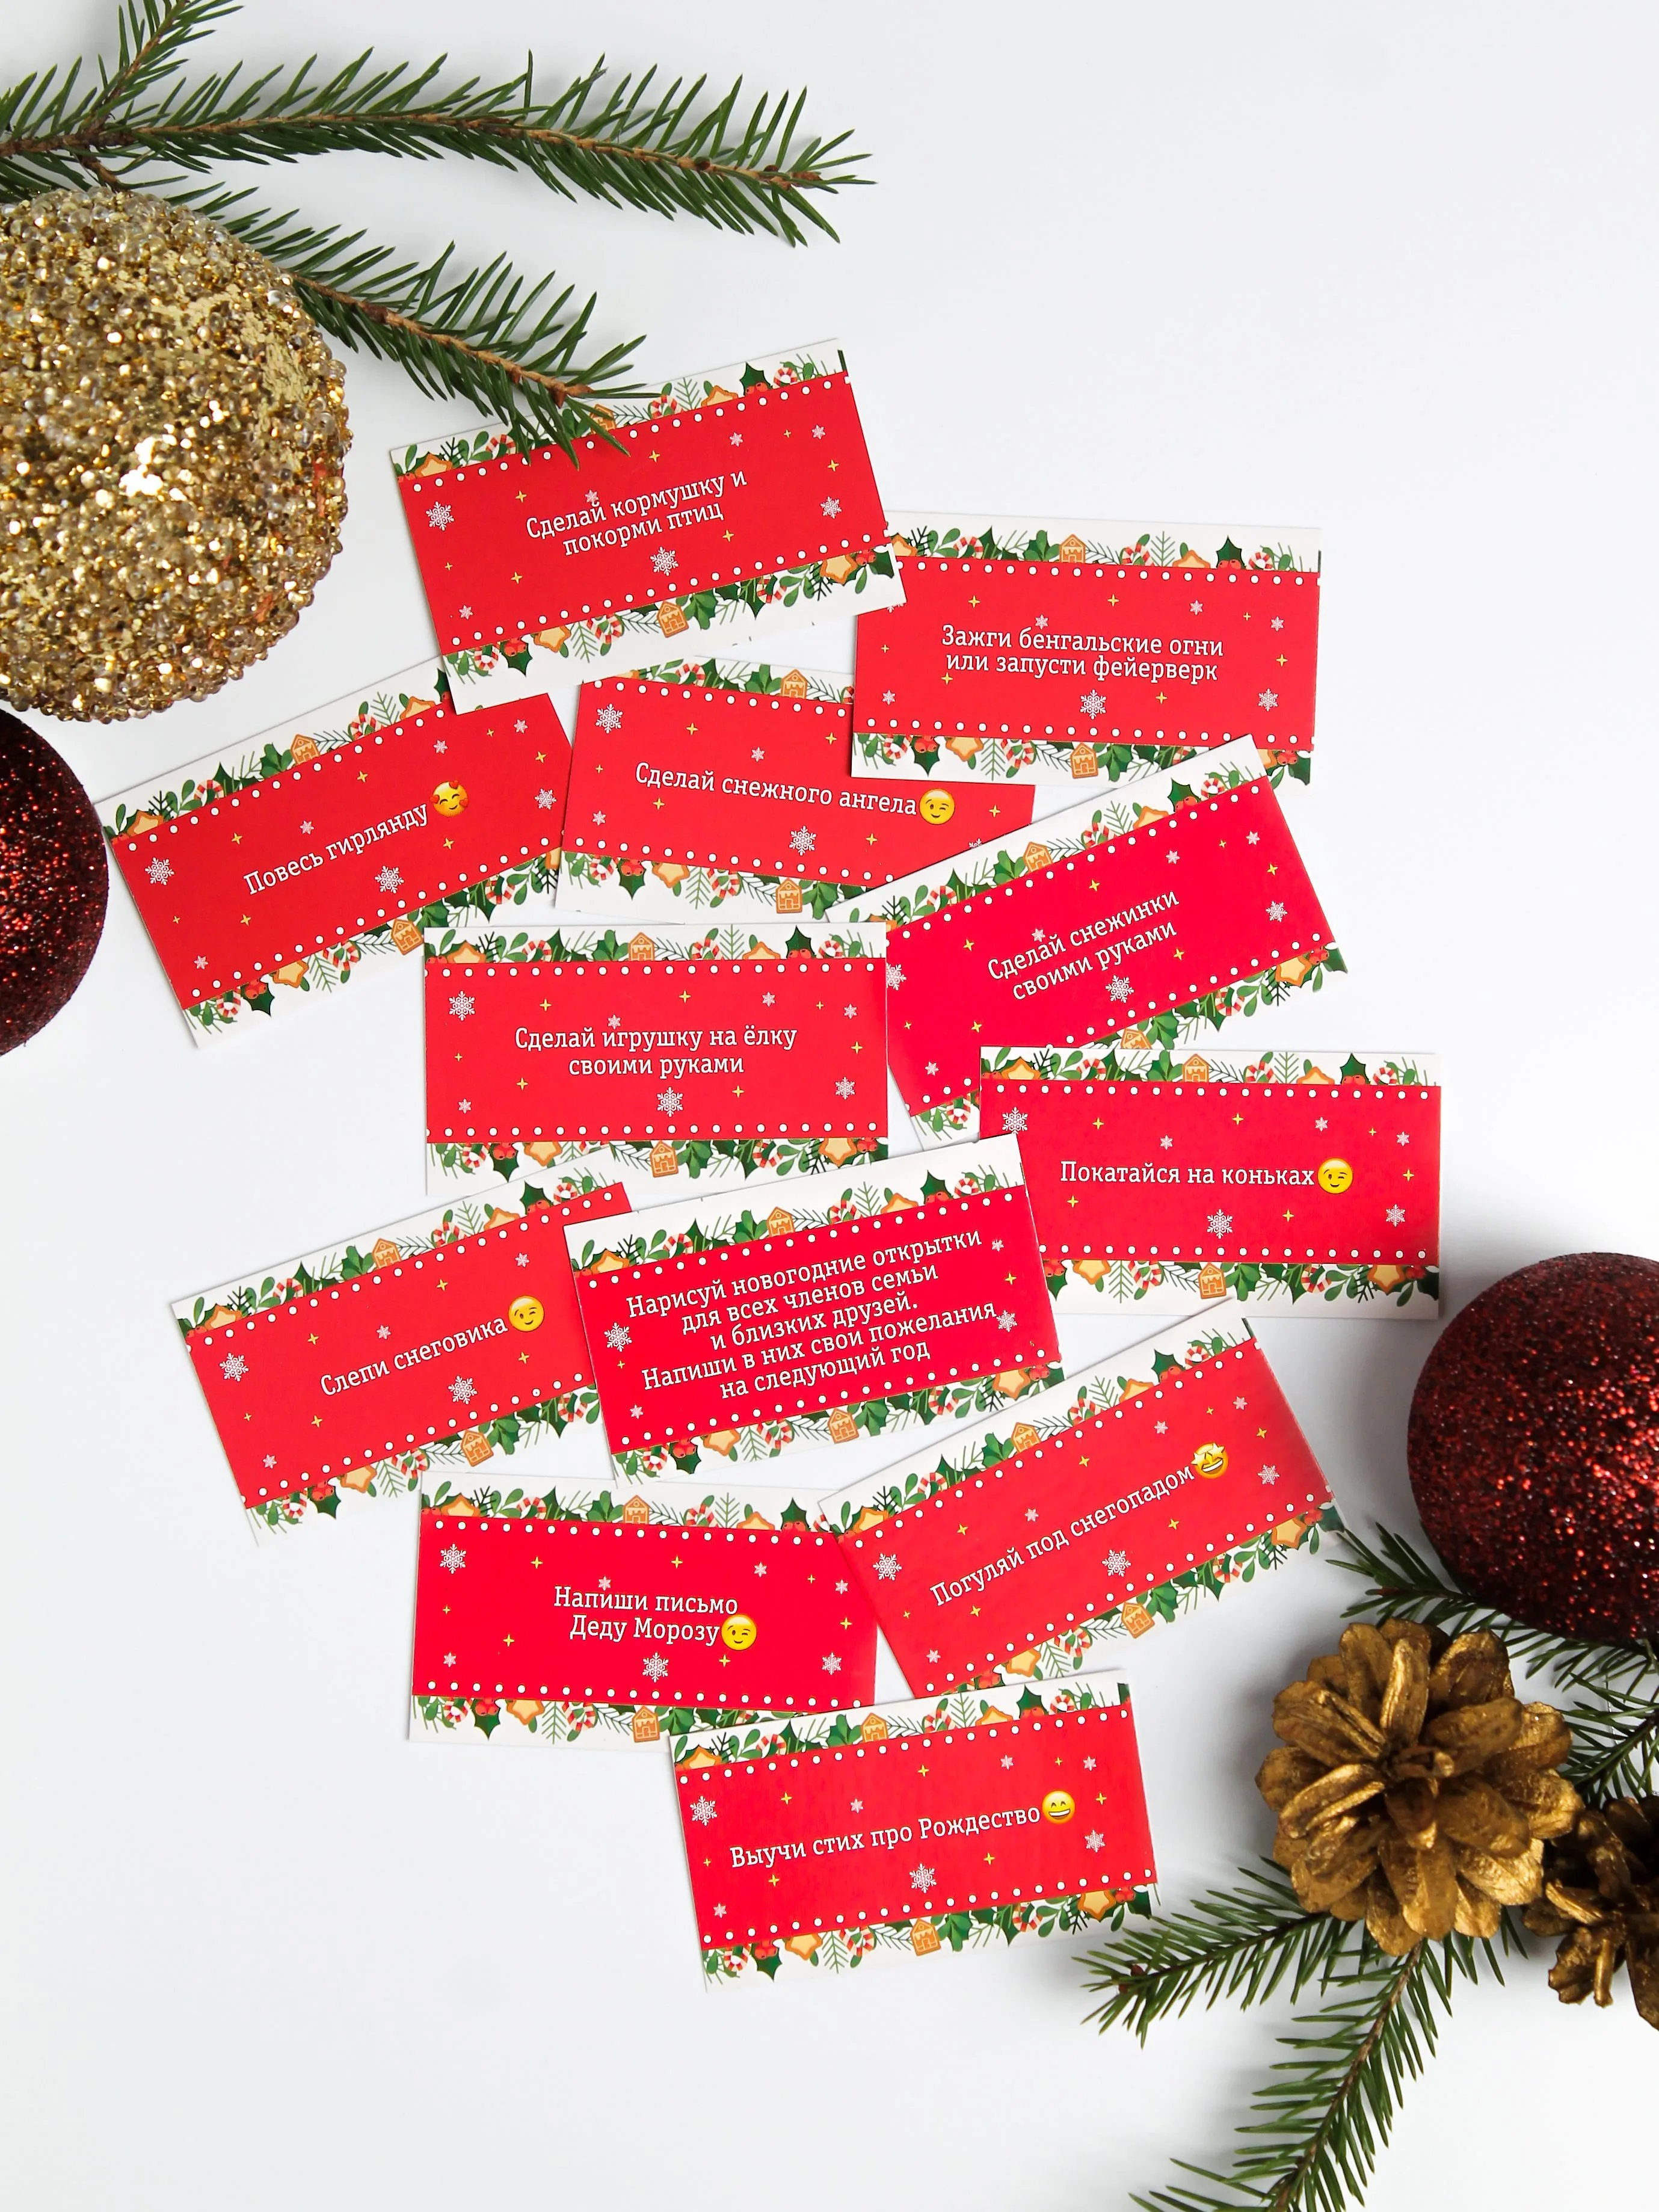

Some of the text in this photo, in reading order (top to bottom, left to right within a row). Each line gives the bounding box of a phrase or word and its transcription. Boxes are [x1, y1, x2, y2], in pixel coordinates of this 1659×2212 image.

[526, 471, 747, 540] Сделай кормушку и
[562, 503, 724, 556] покорми птиц
[942, 624, 1223, 656] Зажги бенгальские огни
[946, 655, 1217, 685] или запусти фейерверк
[636, 762, 917, 815] Сделай снежного ангела
[243, 804, 427, 895] Повесь гирлянду
[988, 891, 1180, 979] Сделай снежинки
[1013, 922, 1177, 1000] своими руками
[516, 1024, 798, 1052] Сделай игрушку на ёлку
[569, 1058, 744, 1079] своими руками
[1060, 1160, 1315, 1185] Покатайся на коньках
[626, 1230, 982, 1318] Нарисуй новогодние открытки
[682, 1265, 939, 1336] для всех членов семьи
[641, 1302, 997, 1390] Напиши в них свои пожелания
[710, 1295, 918, 1351] и близких друзей.
[321, 1318, 508, 1396] Слепи снеговика
[719, 1342, 931, 1399] на следующий год
[929, 1466, 1195, 1606] Погуляй под снегопадом
[553, 1586, 737, 1615] Напиши письмо
[570, 1614, 720, 1647] Деду Морозу
[729, 1807, 1040, 1868] Выучи стих про Рождество
